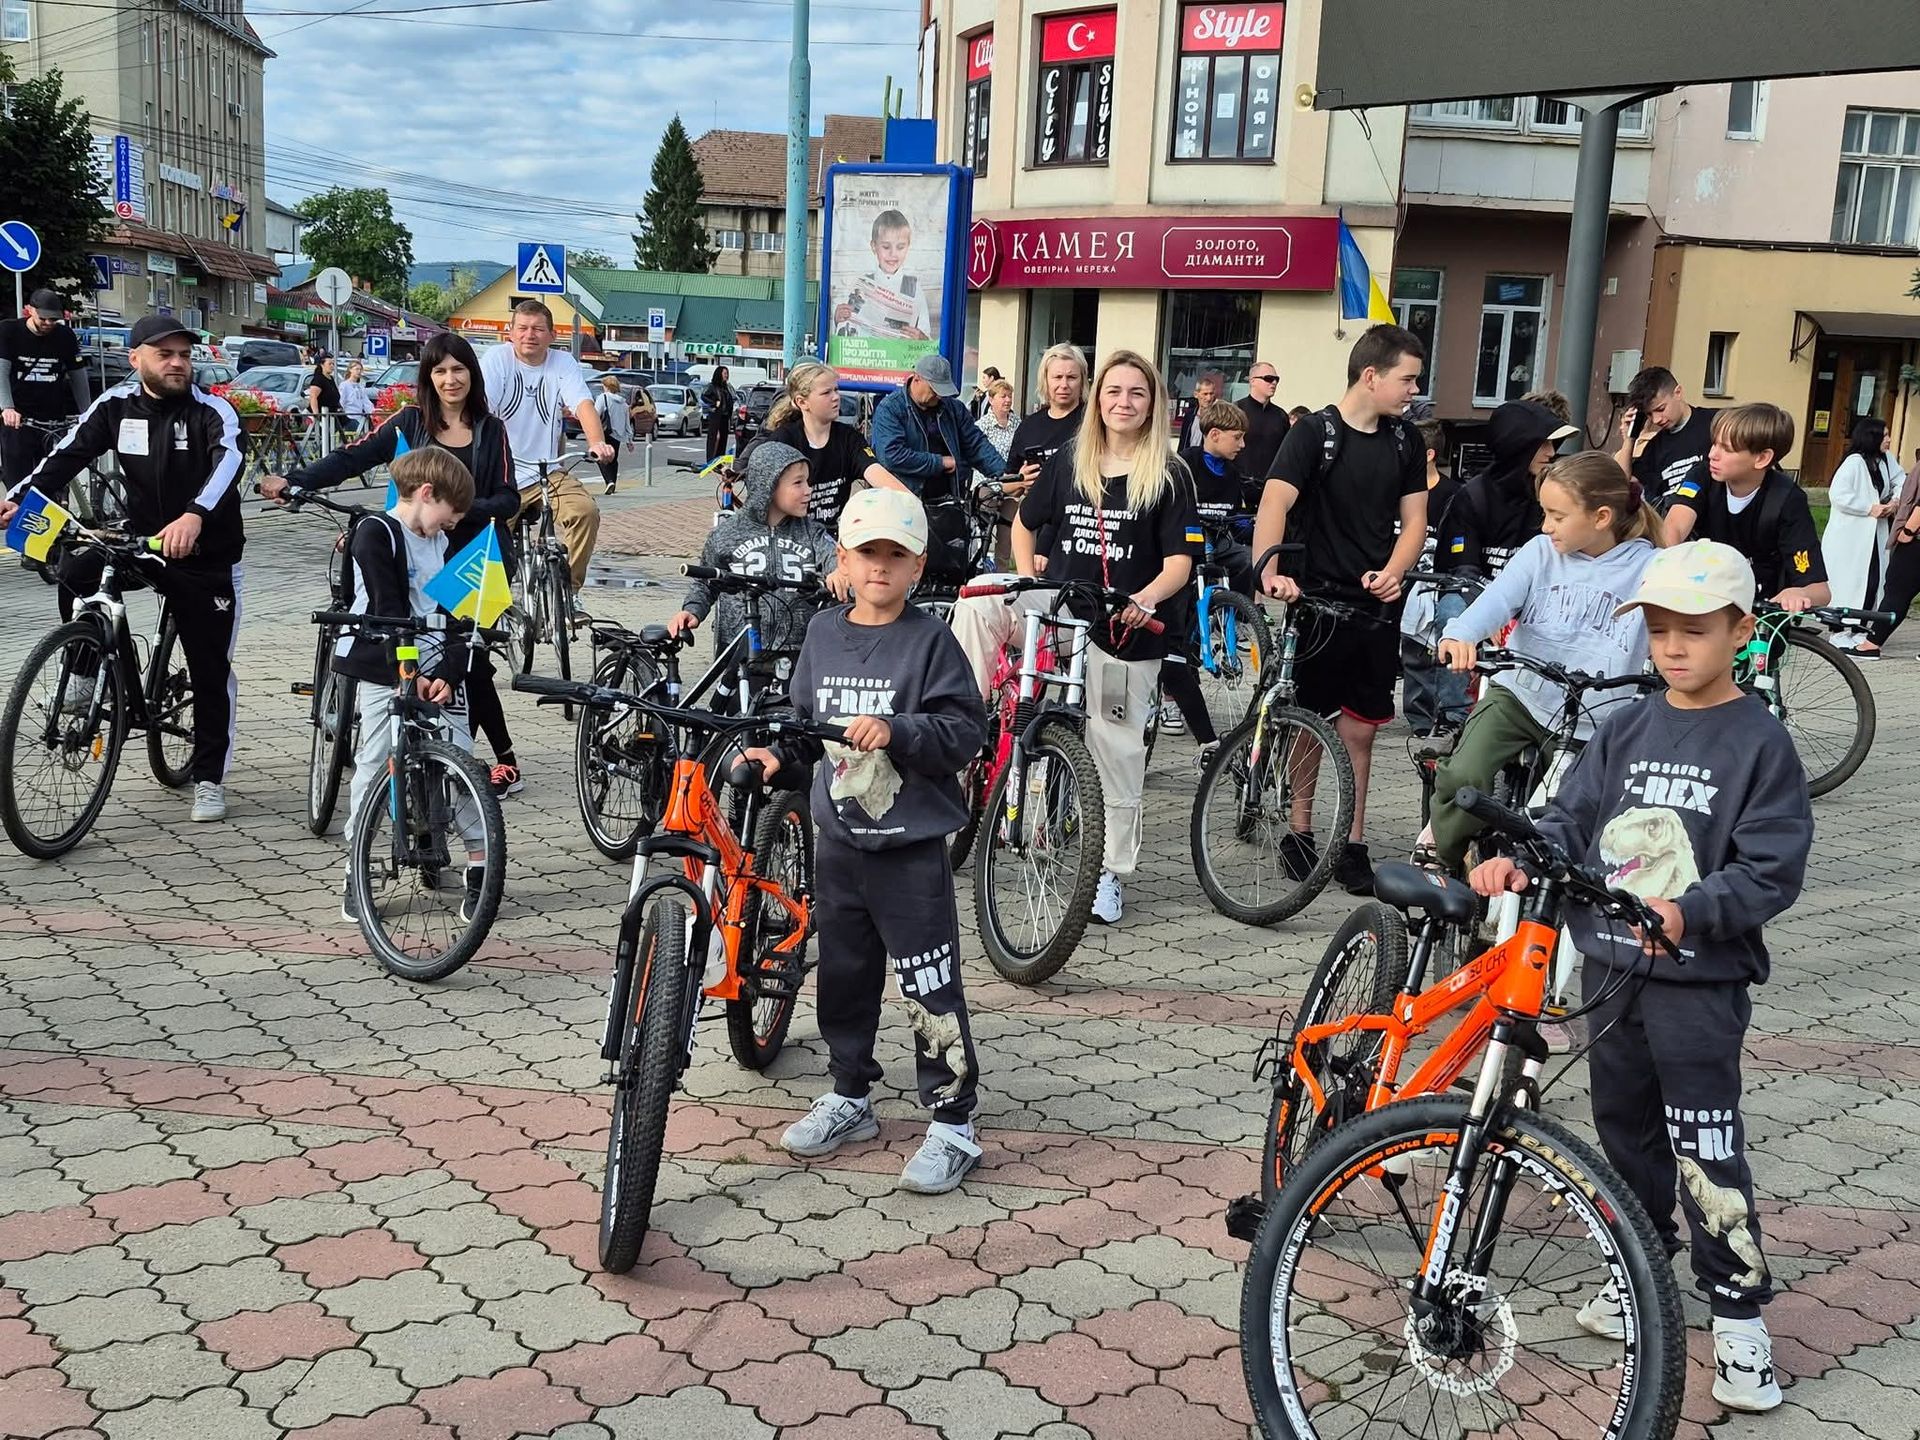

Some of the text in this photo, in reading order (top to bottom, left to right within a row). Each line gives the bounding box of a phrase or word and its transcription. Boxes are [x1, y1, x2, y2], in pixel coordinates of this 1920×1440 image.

[1193, 8, 1271, 47] Style
[1042, 70, 1059, 161] City
[1096, 65, 1111, 158] Style
[1183, 59, 1203, 154] ЖІНОЧИЙ
[1253, 65, 1270, 147] ОДЯГ
[1012, 231, 1135, 262] КАМЕЯ
[1195, 239, 1259, 252] ЗОЛОТО,
[1024, 264, 1117, 274] ЮВЕЛІРНА МЕРЕЖА
[1185, 254, 1265, 267] ДІАМАНТИ
[311, 314, 345, 326] АПТЕА
[371, 337, 384, 354] P
[1082, 506, 1093, 516] НЕ
[732, 536, 812, 559] URBAN STYLE
[1073, 527, 1112, 541] ДЯКУЄО!
[822, 676, 892, 688] DINOSAURS
[816, 688, 896, 715] T-REX
[1425, 1193, 1460, 1286] CORSO
[1274, 1244, 1297, 1310] MOUNTIAN
[1294, 1217, 1312, 1244] BIKE
[1564, 1192, 1614, 1256] CORSO
[1611, 1353, 1635, 1428] MOUNTIAN
